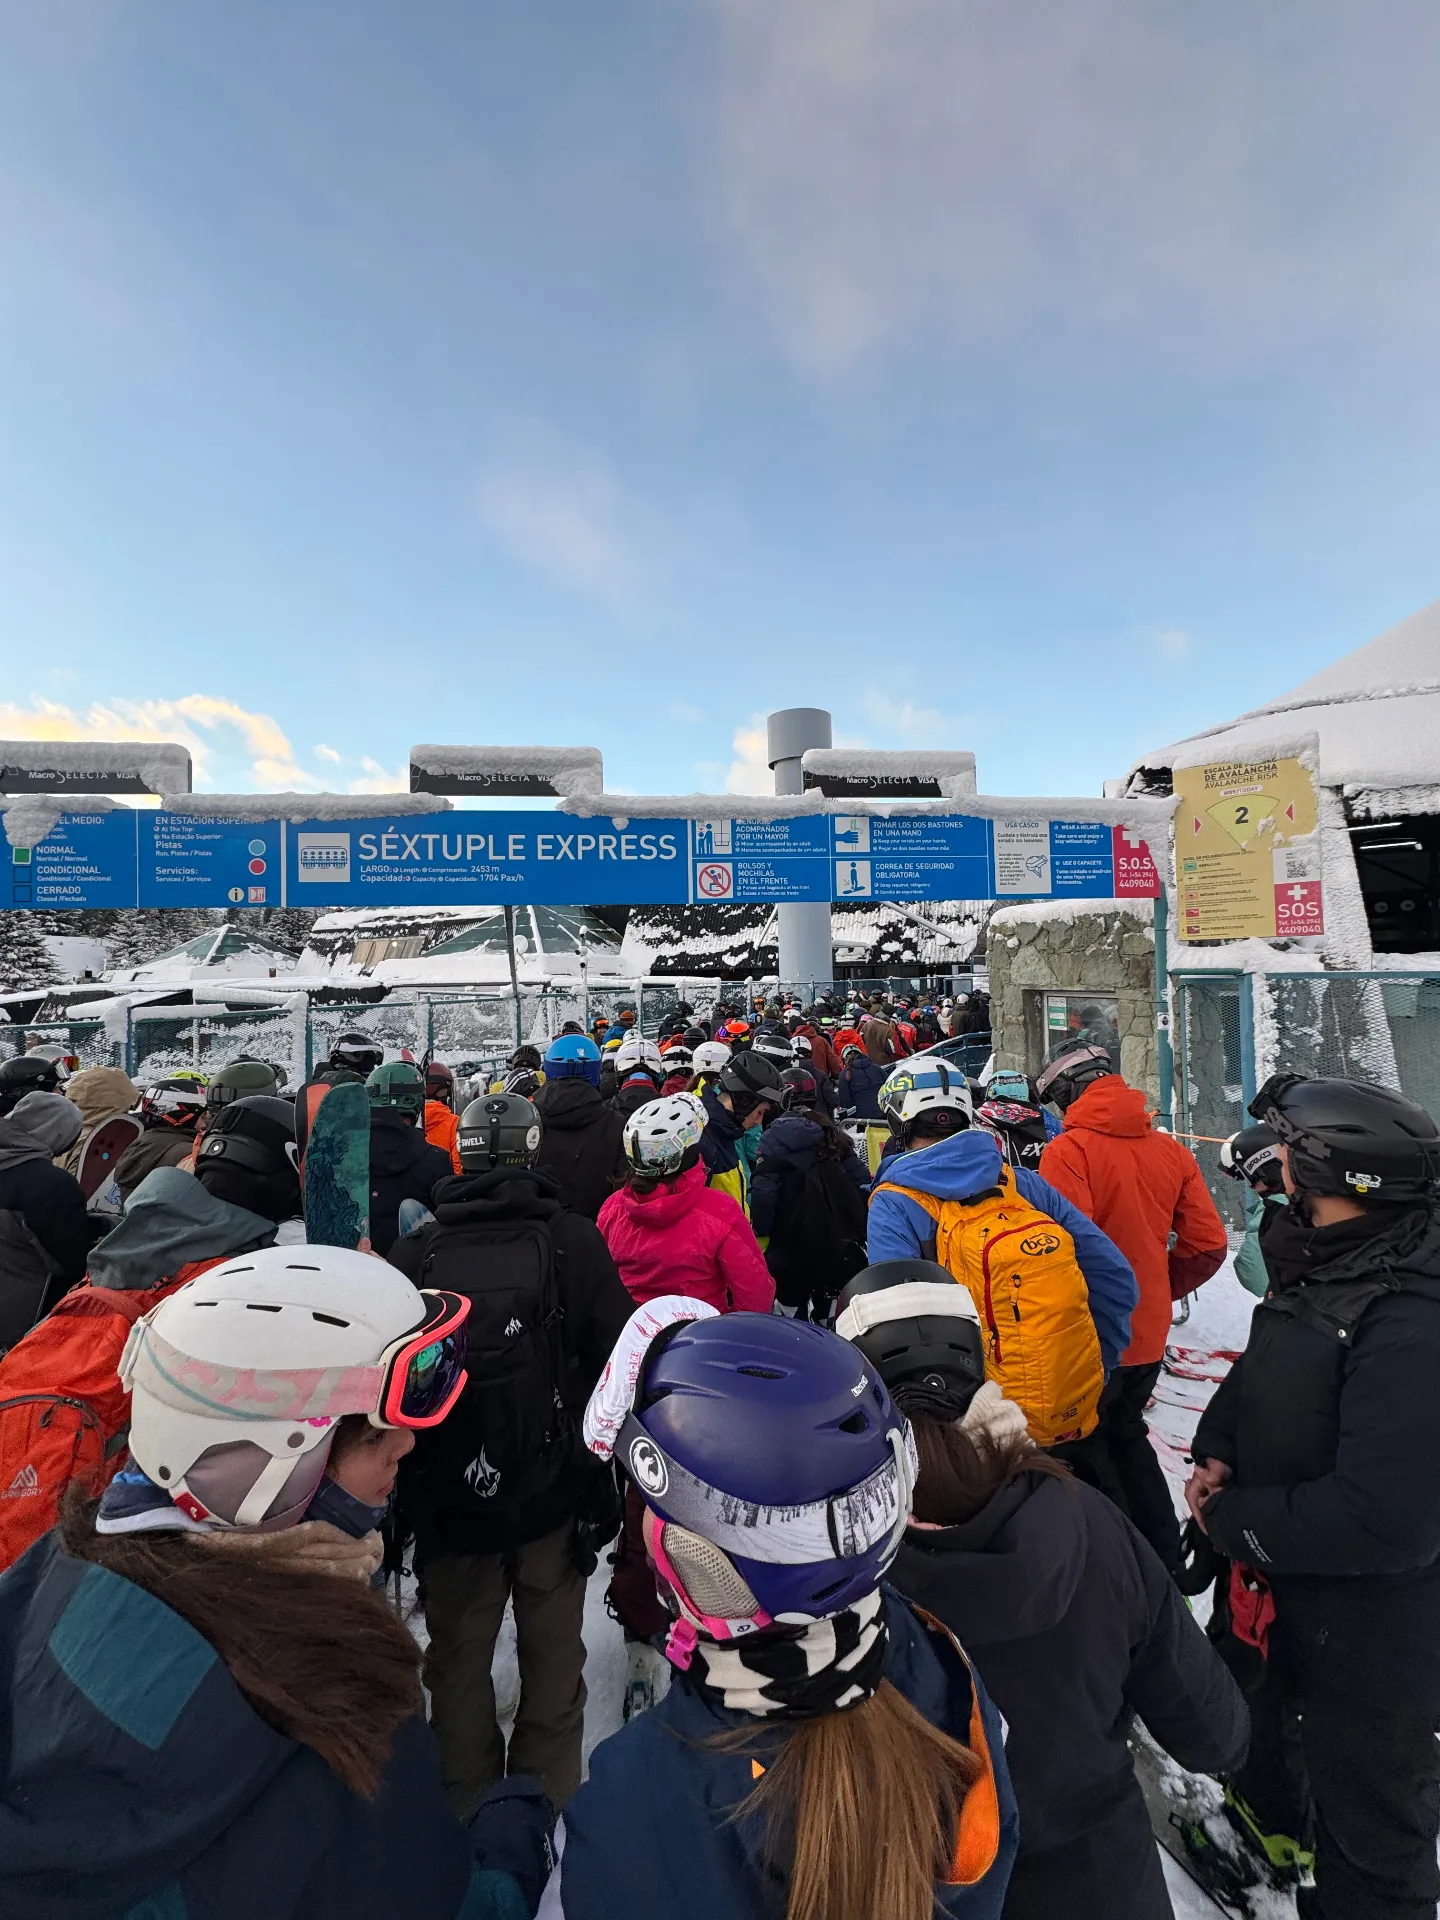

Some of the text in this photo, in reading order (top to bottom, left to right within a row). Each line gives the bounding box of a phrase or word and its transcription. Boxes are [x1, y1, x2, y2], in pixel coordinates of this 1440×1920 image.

[1204, 765, 1232, 775] ESCALA
[1204, 763, 1278, 782] DE AVALANCHA
[29, 771, 56, 779] Macro
[1204, 772, 1278, 790] AVALANCHE RISK
[1234, 806, 1249, 825] 2
[72, 816, 105, 825] MEDIO:
[155, 816, 168, 825] EN
[872, 821, 963, 829] TOMAR LOS DOS BASTONES
[736, 824, 790, 833] ACOMPAÑADOS
[873, 829, 922, 837] EN UNA MANO
[736, 833, 789, 841] POR UN MAYOR
[155, 841, 183, 849] Pistas
[358, 826, 677, 861] SÉXTUPLE EXPRESS
[36, 845, 77, 854] NORMAL
[915, 862, 954, 870] SEGURIDAD
[1118, 857, 1155, 870] S.O.S.
[37, 865, 101, 875] CONDICIONAL
[155, 867, 199, 875] Servicios:
[360, 865, 393, 874] LARGO:
[471, 865, 491, 873] 2453
[480, 874, 499, 882] 1704
[501, 873, 525, 883] Pax/h
[875, 871, 920, 879] OBLIGATORIA
[1118, 880, 1154, 888] 4409040
[37, 886, 81, 895] CERRADO
[1277, 902, 1320, 918] SOS
[461, 1136, 486, 1147] SWELL
